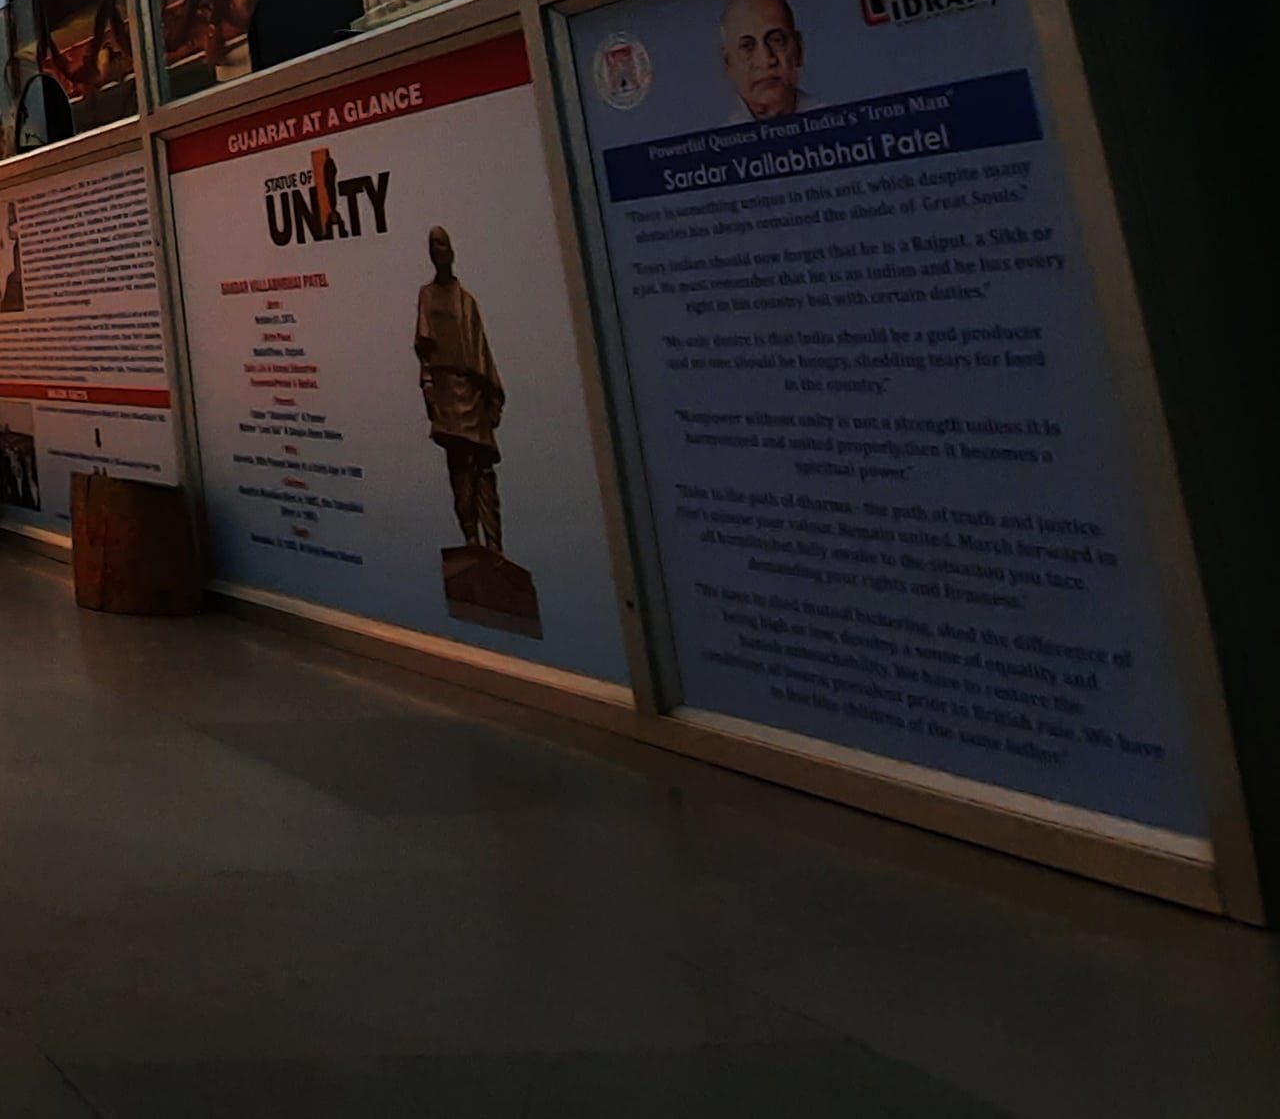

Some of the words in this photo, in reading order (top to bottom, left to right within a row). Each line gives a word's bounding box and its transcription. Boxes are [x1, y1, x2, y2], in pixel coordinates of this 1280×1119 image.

[228, 118, 297, 153] GUJARAT
[302, 111, 323, 135] AT
[328, 108, 339, 127] A
[343, 83, 423, 123] GLANCE
[648, 136, 705, 159] Powerful
[708, 131, 758, 151] Quotes
[760, 123, 800, 139] From
[802, 109, 857, 132] India's
[264, 173, 299, 193] STATUE
[300, 170, 313, 185] OF
[663, 164, 726, 190] Sardar
[732, 136, 874, 177] Vallabhbhai
[880, 123, 948, 157] Patel
[303, 273, 328, 288] PATEL
